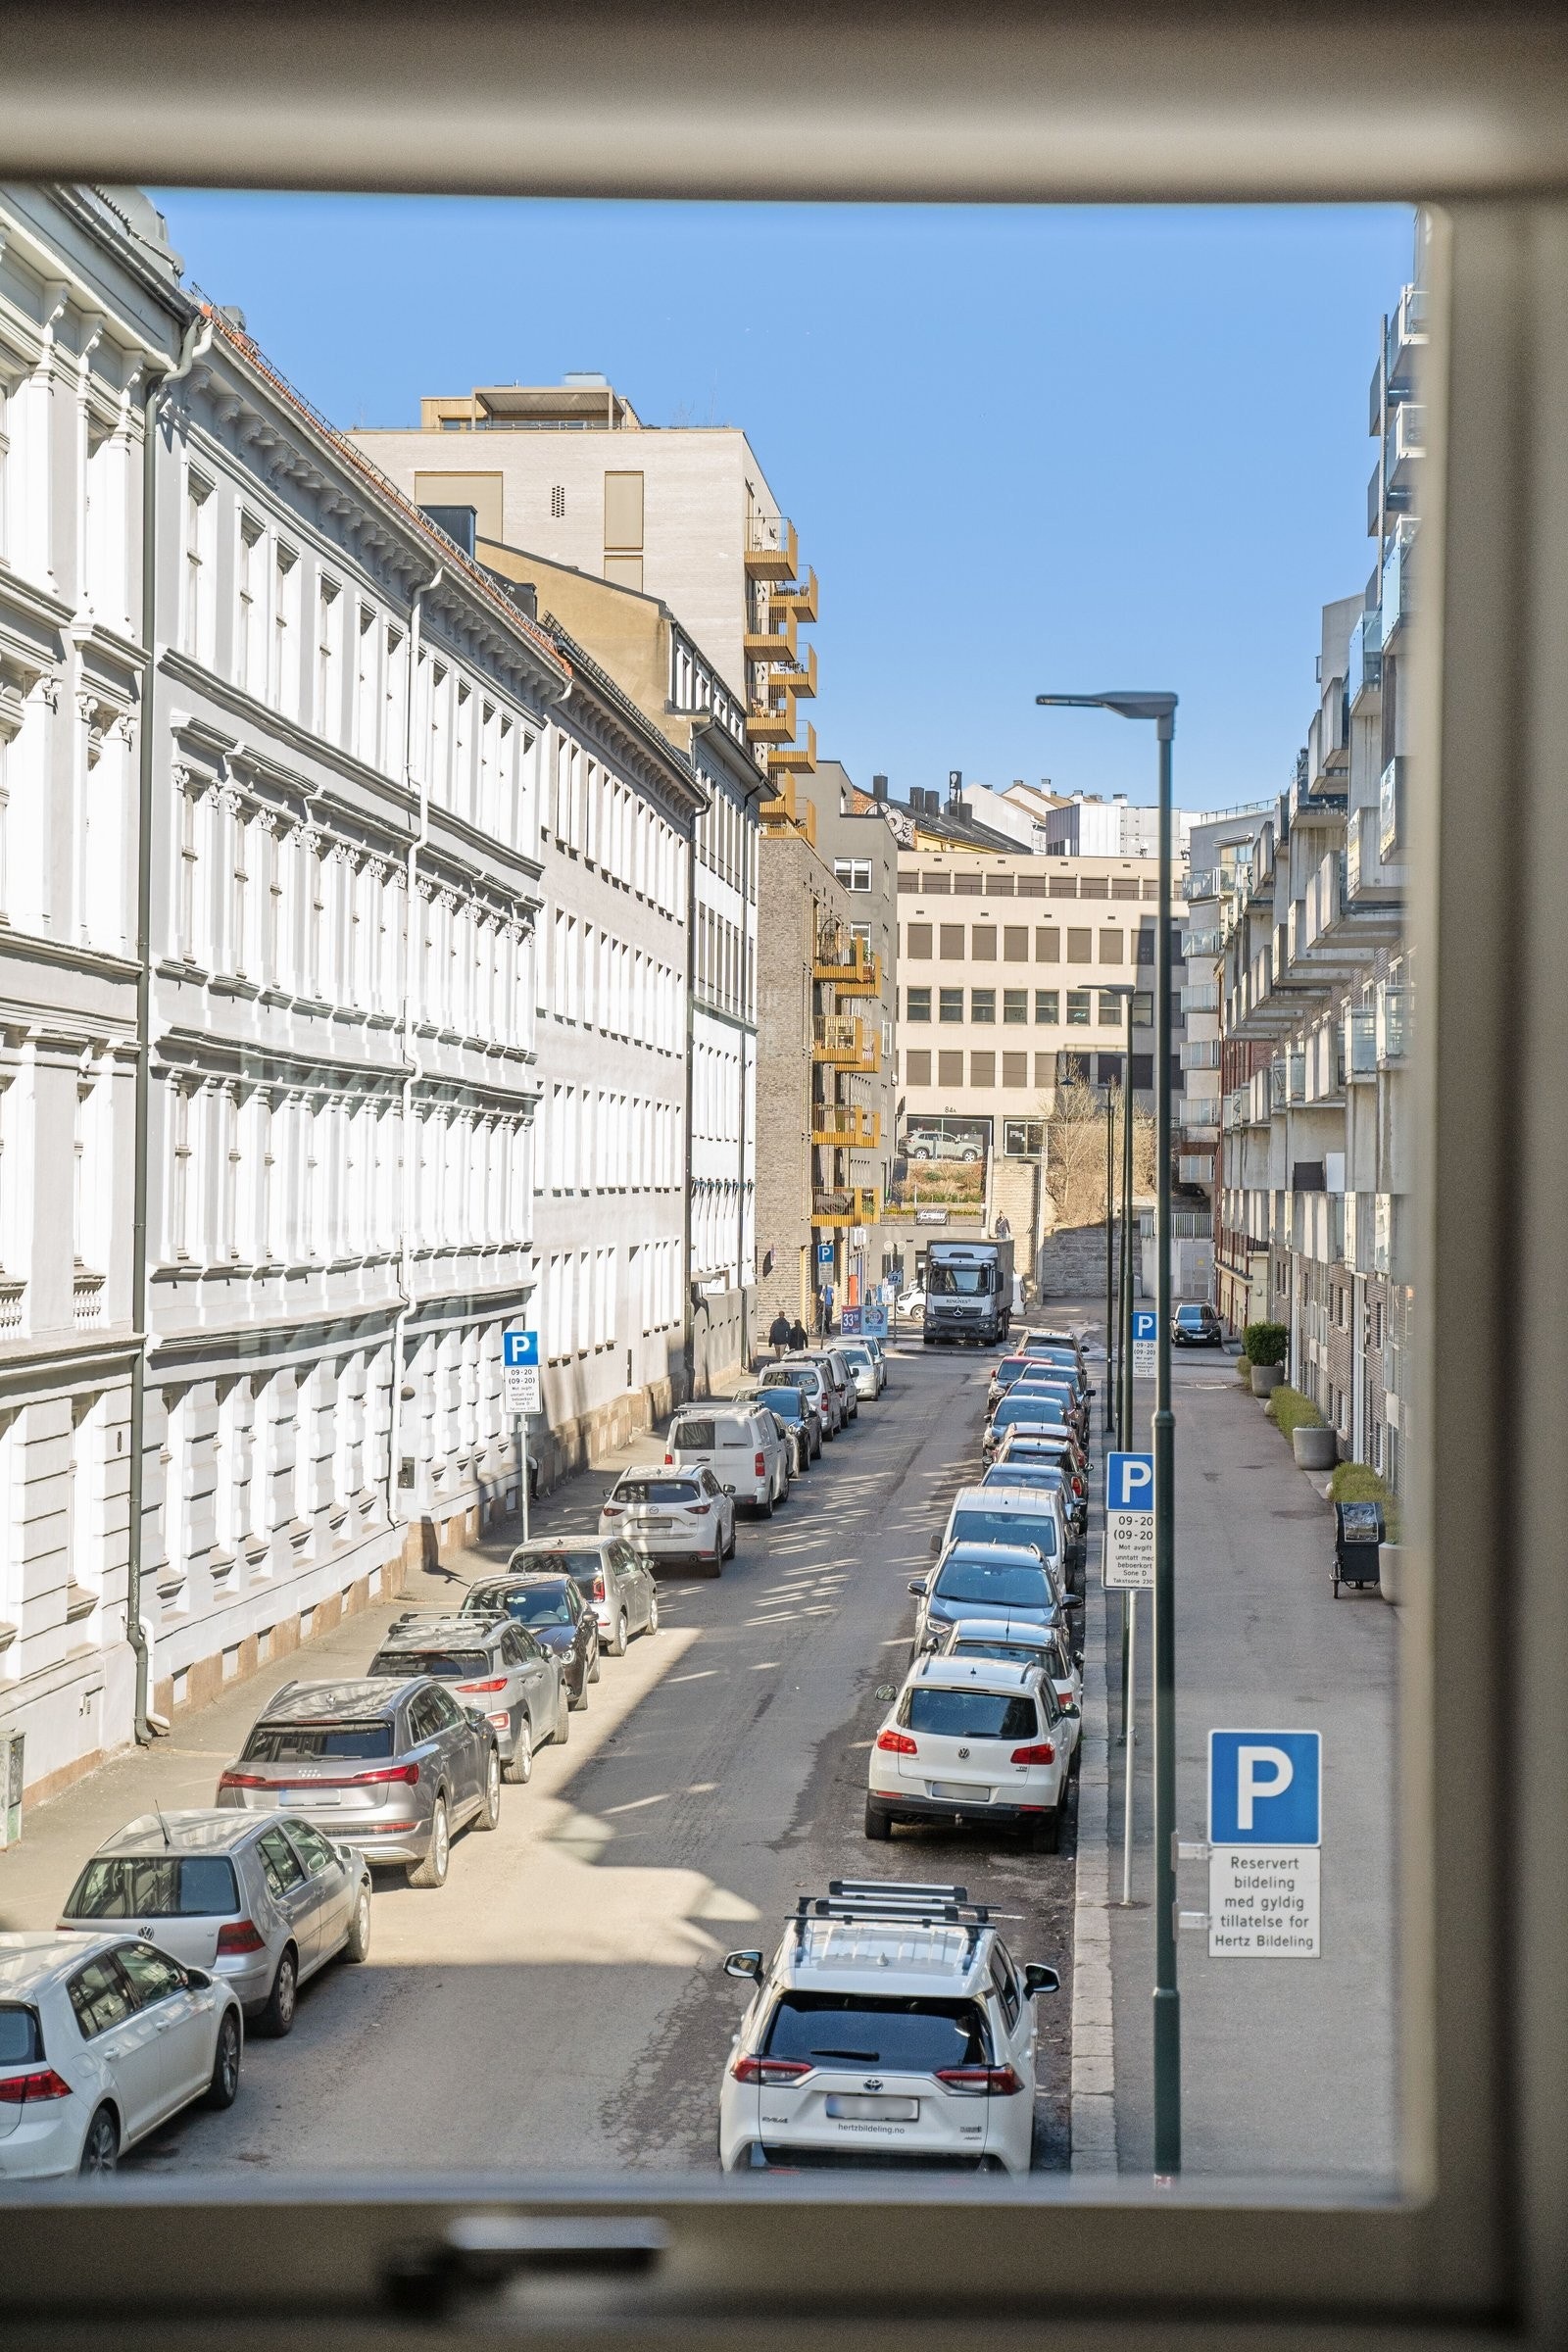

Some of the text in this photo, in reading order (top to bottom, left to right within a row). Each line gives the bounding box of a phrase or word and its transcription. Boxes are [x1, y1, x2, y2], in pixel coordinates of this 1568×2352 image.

[821, 1247, 830, 1260] P
[843, 1313, 854, 1327] 33
[1138, 1315, 1153, 1337] P
[512, 1336, 530, 1362] P
[1121, 1461, 1152, 1503] P
[1113, 1529, 1153, 1541] (09-20
[1237, 1745, 1294, 1830] P
[1231, 1856, 1299, 1870] Reservert
[1234, 1876, 1296, 1891] bildeling
[1225, 1895, 1304, 1911] med gyldig
[1220, 1915, 1309, 1928] tillatelse for
[1215, 1935, 1314, 1949] Hertz Bildeling
[838, 2123, 906, 2135] hertzbildeling.no
